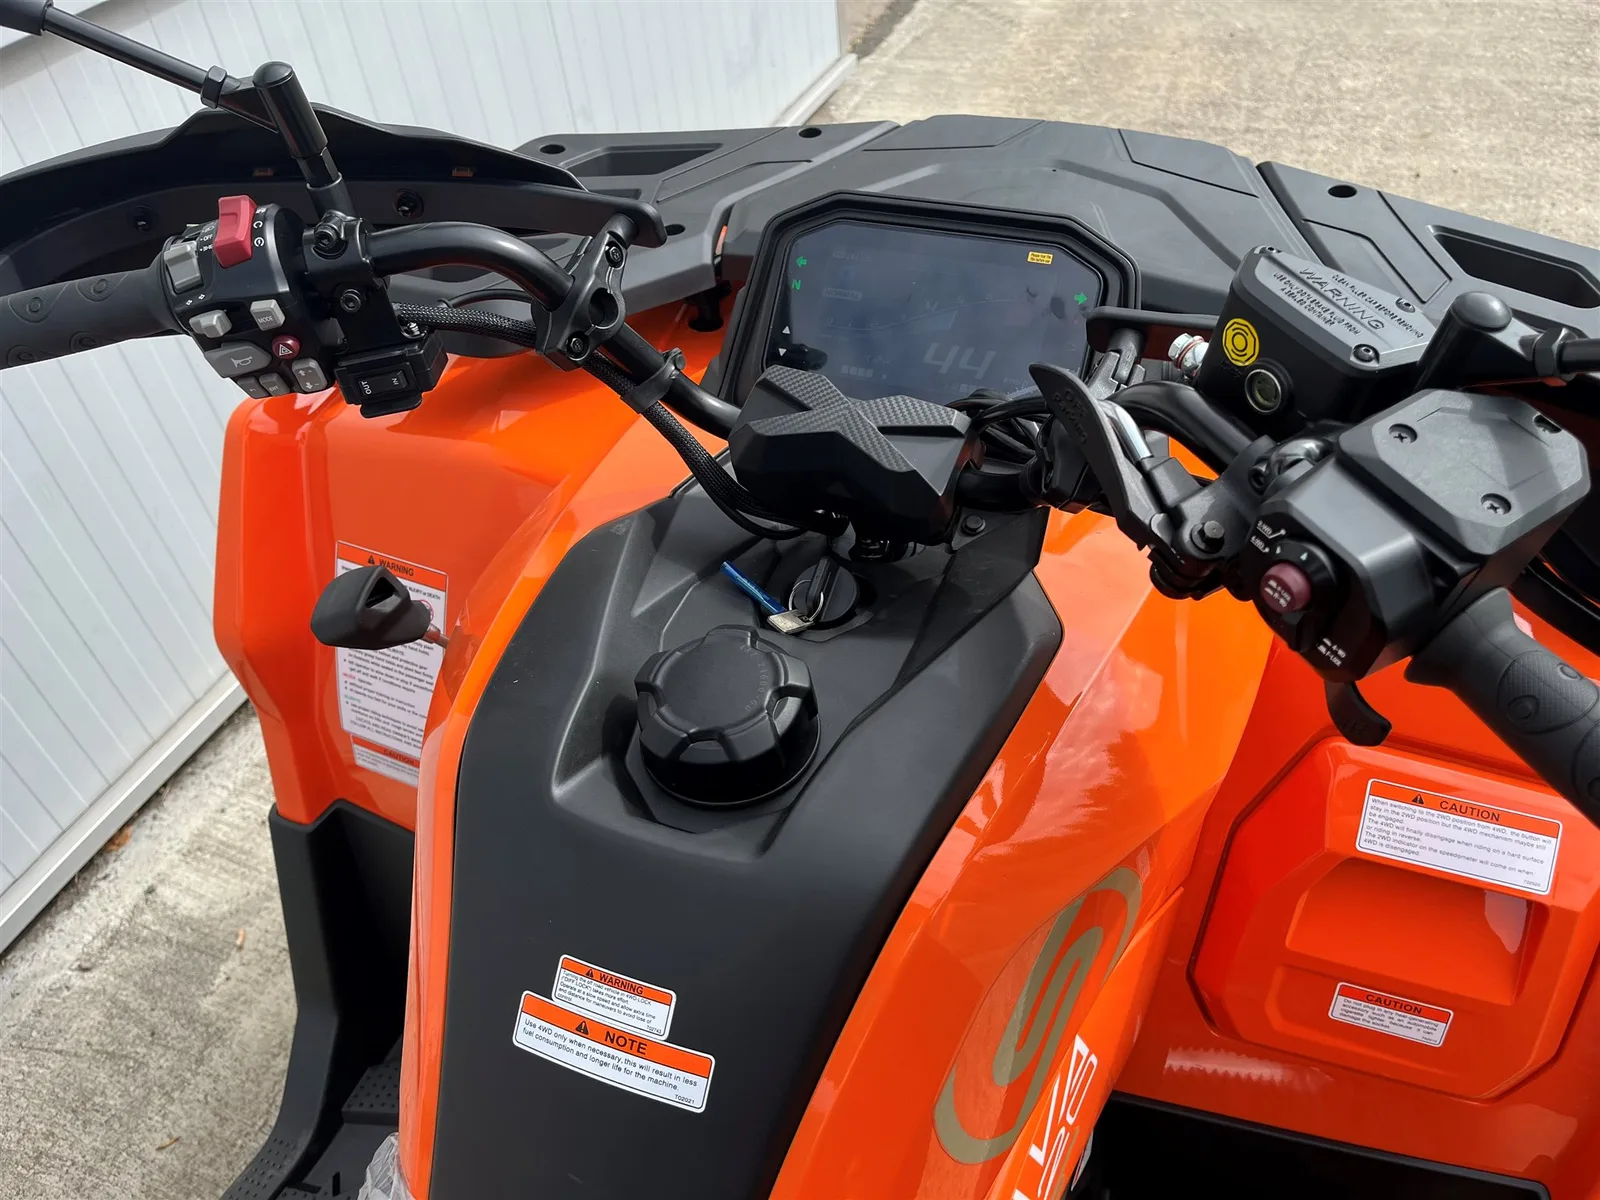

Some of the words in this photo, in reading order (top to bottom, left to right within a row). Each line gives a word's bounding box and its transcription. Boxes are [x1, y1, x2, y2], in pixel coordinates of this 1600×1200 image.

[792, 279, 802, 291] N
[1300, 268, 1384, 330] WARNING
[924, 342, 996, 380] 44
[360, 380, 372, 395] OUT
[379, 558, 413, 576] WARNING
[1371, 798, 1388, 806] When
[1389, 802, 1417, 814] switching
[1451, 816, 1475, 827] position
[1521, 832, 1540, 842] button
[1438, 800, 1500, 822] CAUTION
[1373, 826, 1390, 835] riding
[1416, 815, 1439, 826] position
[1478, 830, 1513, 842] mechanism
[1514, 838, 1534, 848] maybe
[1392, 838, 1417, 848] indicator
[1438, 849, 1478, 864] speedometer
[1490, 862, 1506, 870] come
[1517, 867, 1533, 876] when
[1405, 827, 1423, 836] finally
[1424, 831, 1455, 844] disengage
[1456, 839, 1472, 847] when
[1474, 843, 1491, 852] riding
[1522, 855, 1544, 864] surface
[598, 973, 643, 995] WARNING
[1365, 994, 1422, 1014] CAUTION
[524, 1019, 537, 1029] Use
[537, 1024, 552, 1035] 4WD
[553, 1031, 567, 1042] only
[568, 1037, 586, 1049] when
[624, 1058, 637, 1067] this
[638, 1062, 650, 1072] will
[652, 1066, 672, 1079] result
[674, 1073, 681, 1082] in
[682, 1076, 697, 1087] less
[604, 1030, 648, 1055] NOTE
[522, 1027, 534, 1037] fuel
[534, 1033, 574, 1054] consumption
[575, 1049, 588, 1059] and
[589, 1054, 610, 1069] longer
[612, 1062, 622, 1072] life
[623, 1067, 633, 1076] for
[634, 1070, 646, 1080] the
[647, 1074, 679, 1092] machine.
